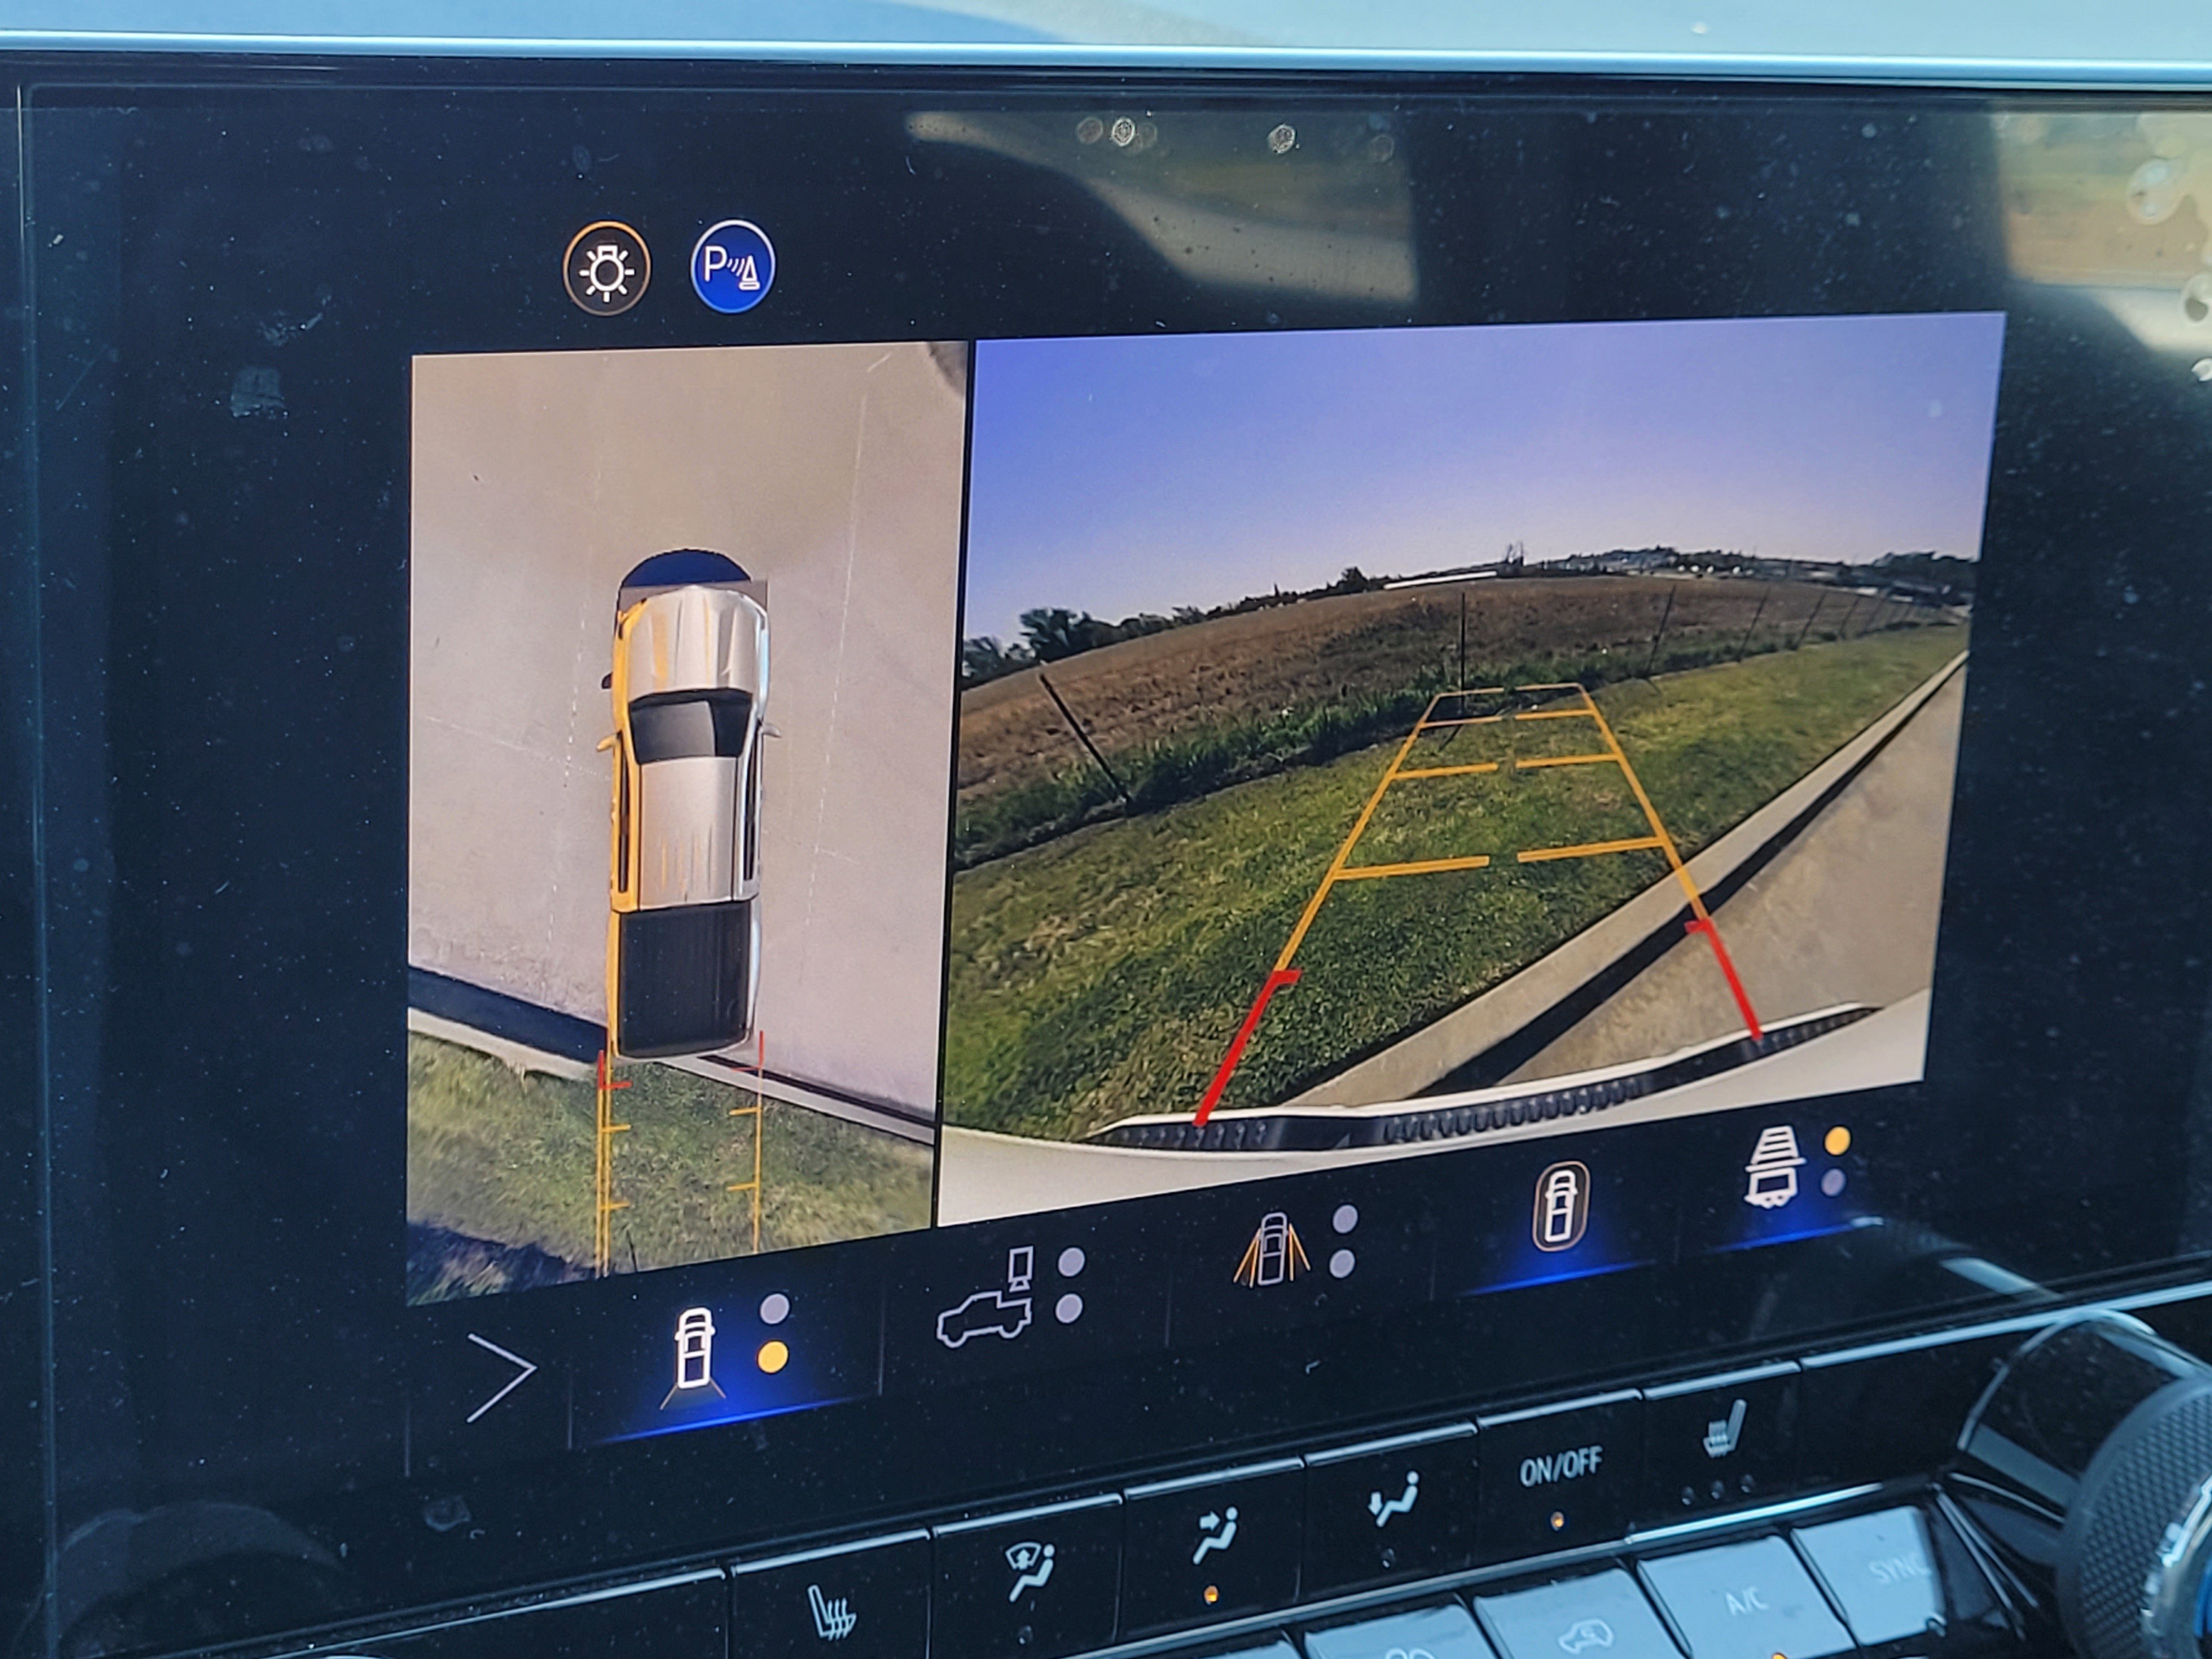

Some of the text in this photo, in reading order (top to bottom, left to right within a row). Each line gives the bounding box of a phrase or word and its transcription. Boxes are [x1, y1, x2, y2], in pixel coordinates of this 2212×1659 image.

[704, 245, 727, 282] P
[1520, 1445, 1603, 1487] ON/OFF
[1868, 1552, 1931, 1584] SYNC
[1725, 1586, 1769, 1616] A/C
